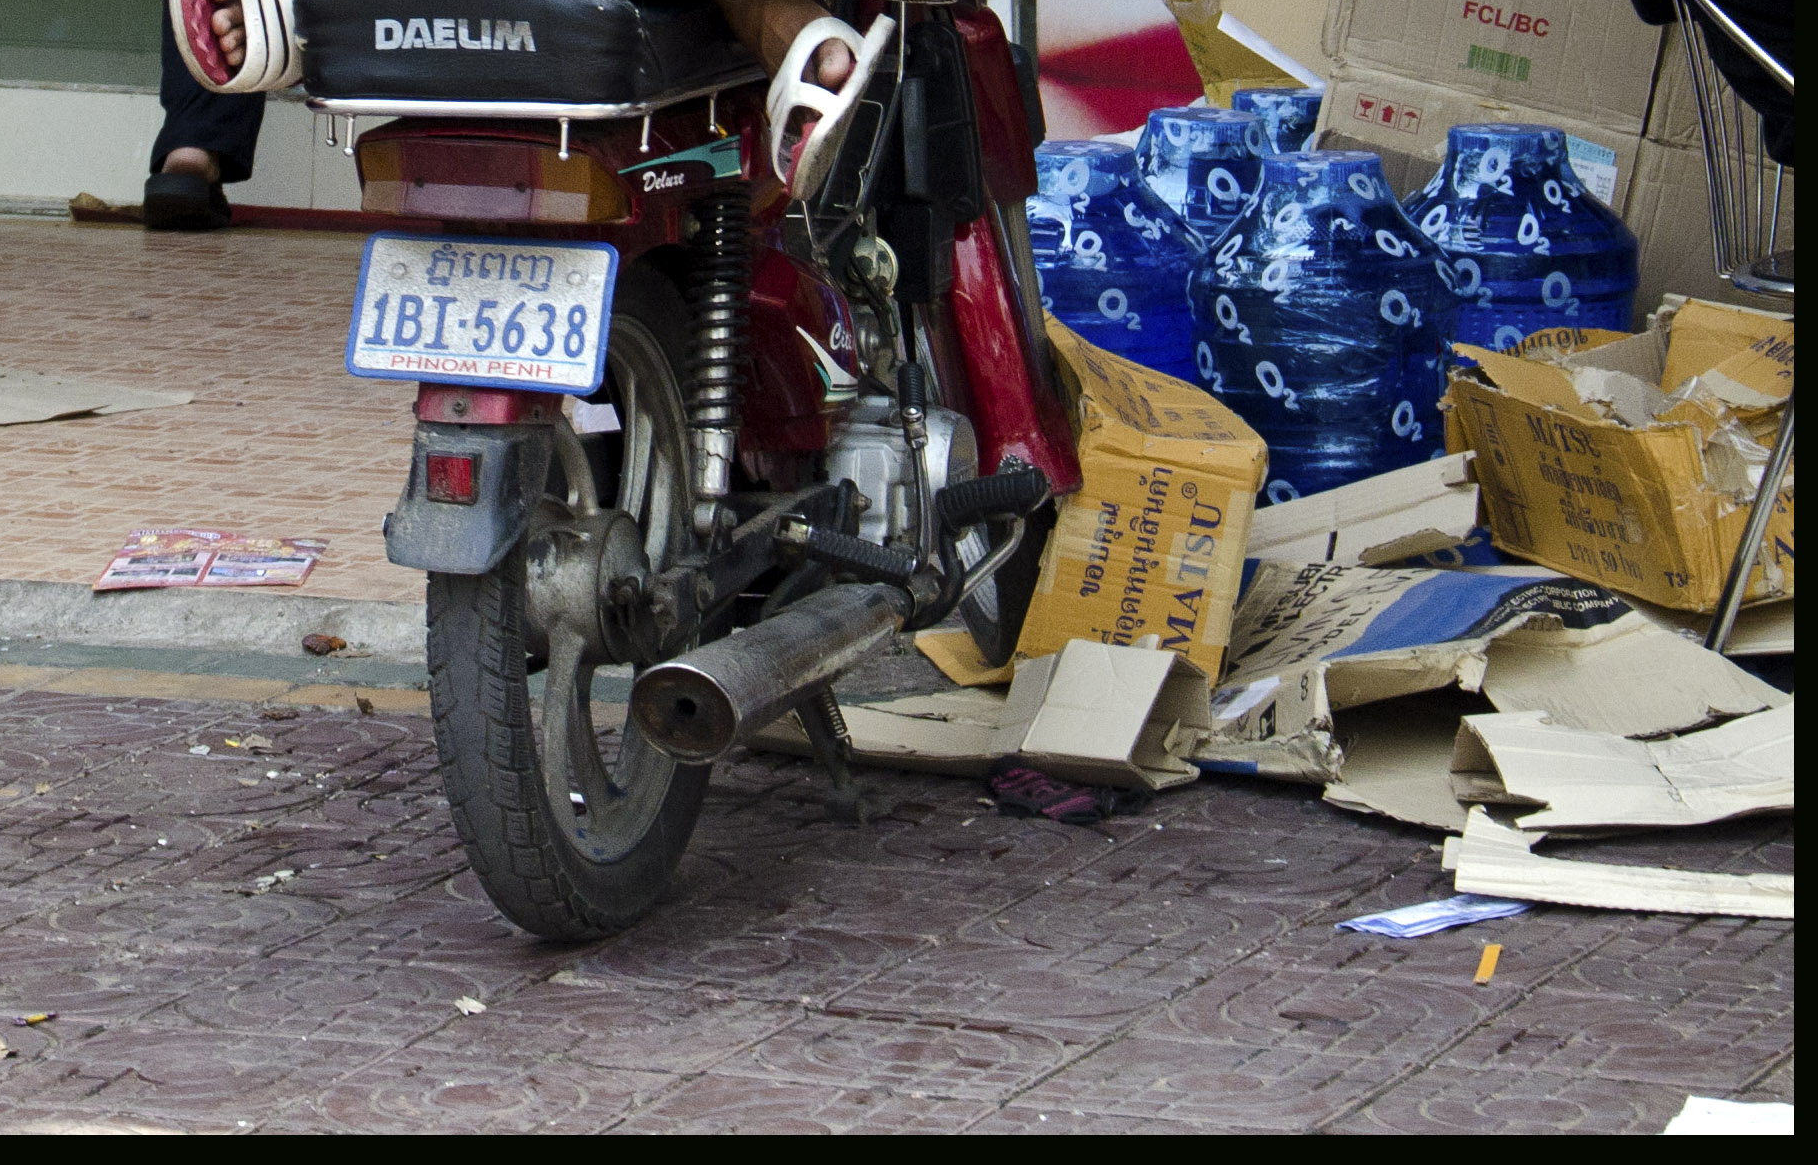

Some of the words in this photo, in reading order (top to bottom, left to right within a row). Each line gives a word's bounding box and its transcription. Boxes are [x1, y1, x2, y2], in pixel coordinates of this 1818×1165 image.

[374, 17, 537, 53] DAELIM
[1462, 0, 1551, 37] FCL/BC
[642, 169, 686, 194] Deluxe
[364, 291, 588, 359] 1BI-5638
[390, 354, 478, 374] PHNOM
[487, 360, 553, 380] PENH
[1078, 501, 1122, 600] ขอบคุณ
